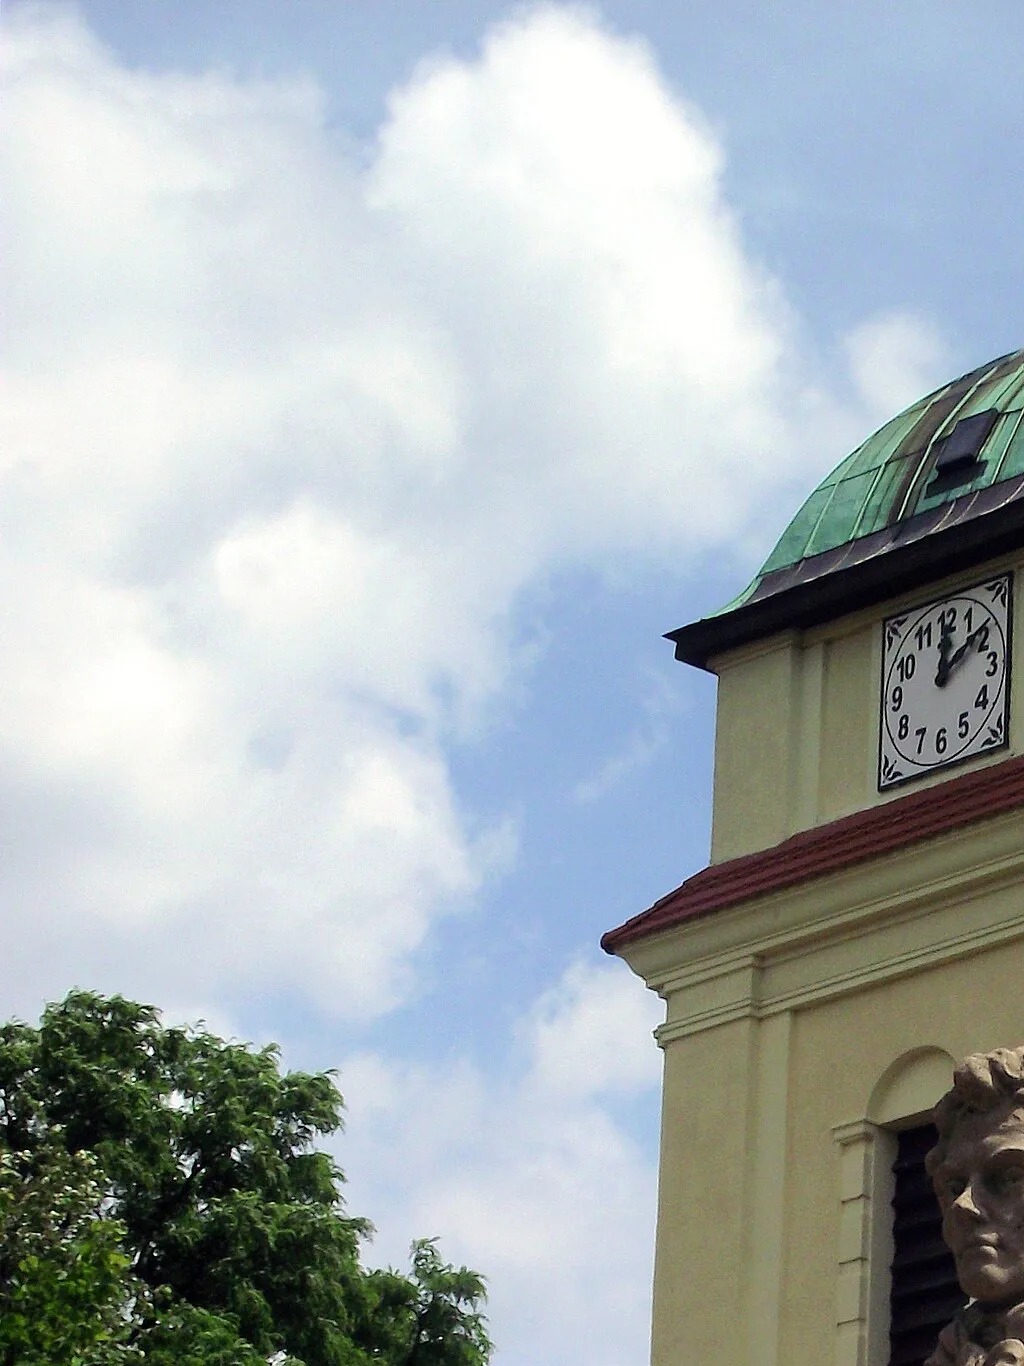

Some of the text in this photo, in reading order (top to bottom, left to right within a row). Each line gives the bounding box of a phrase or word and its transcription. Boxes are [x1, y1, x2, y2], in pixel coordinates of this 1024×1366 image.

[938, 607, 957, 635] 12
[964, 607, 973, 632] 1
[915, 622, 932, 650] 11
[977, 625, 990, 653] 2
[897, 654, 916, 682] 10
[986, 652, 998, 677] 3
[892, 686, 903, 712] 9
[975, 684, 988, 710] 4
[899, 714, 909, 740] 8
[958, 712, 970, 739] 5
[915, 728, 927, 754] 7
[936, 728, 947, 754] 6
